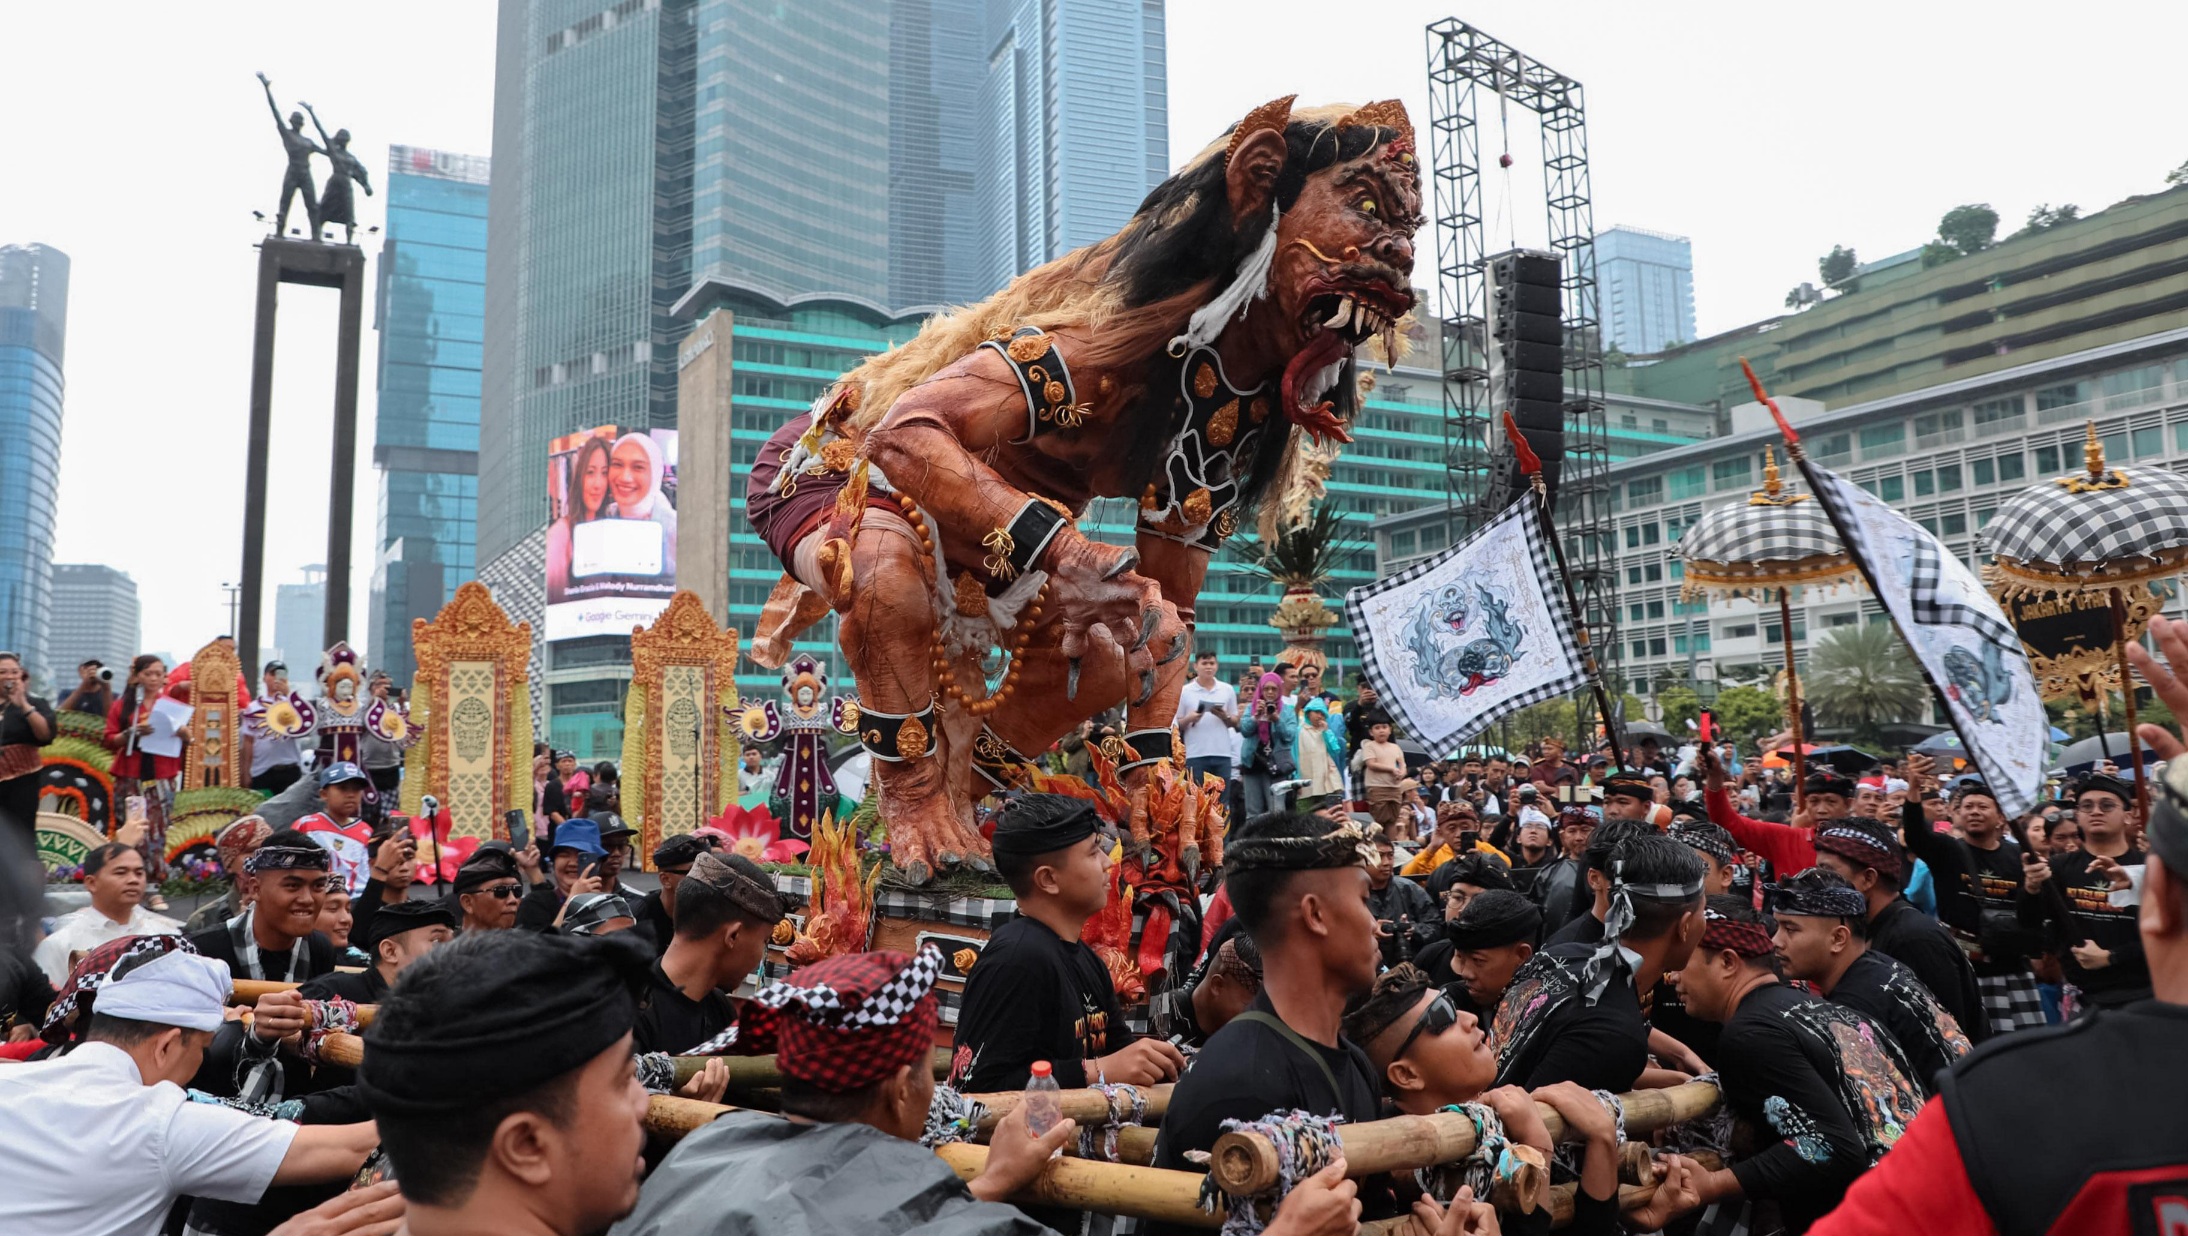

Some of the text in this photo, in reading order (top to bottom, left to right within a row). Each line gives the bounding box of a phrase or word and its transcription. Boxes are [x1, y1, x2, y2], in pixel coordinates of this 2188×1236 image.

[586, 610, 653, 623] Google Gemini
[2020, 592, 2108, 621] JAKARTA UTAR
